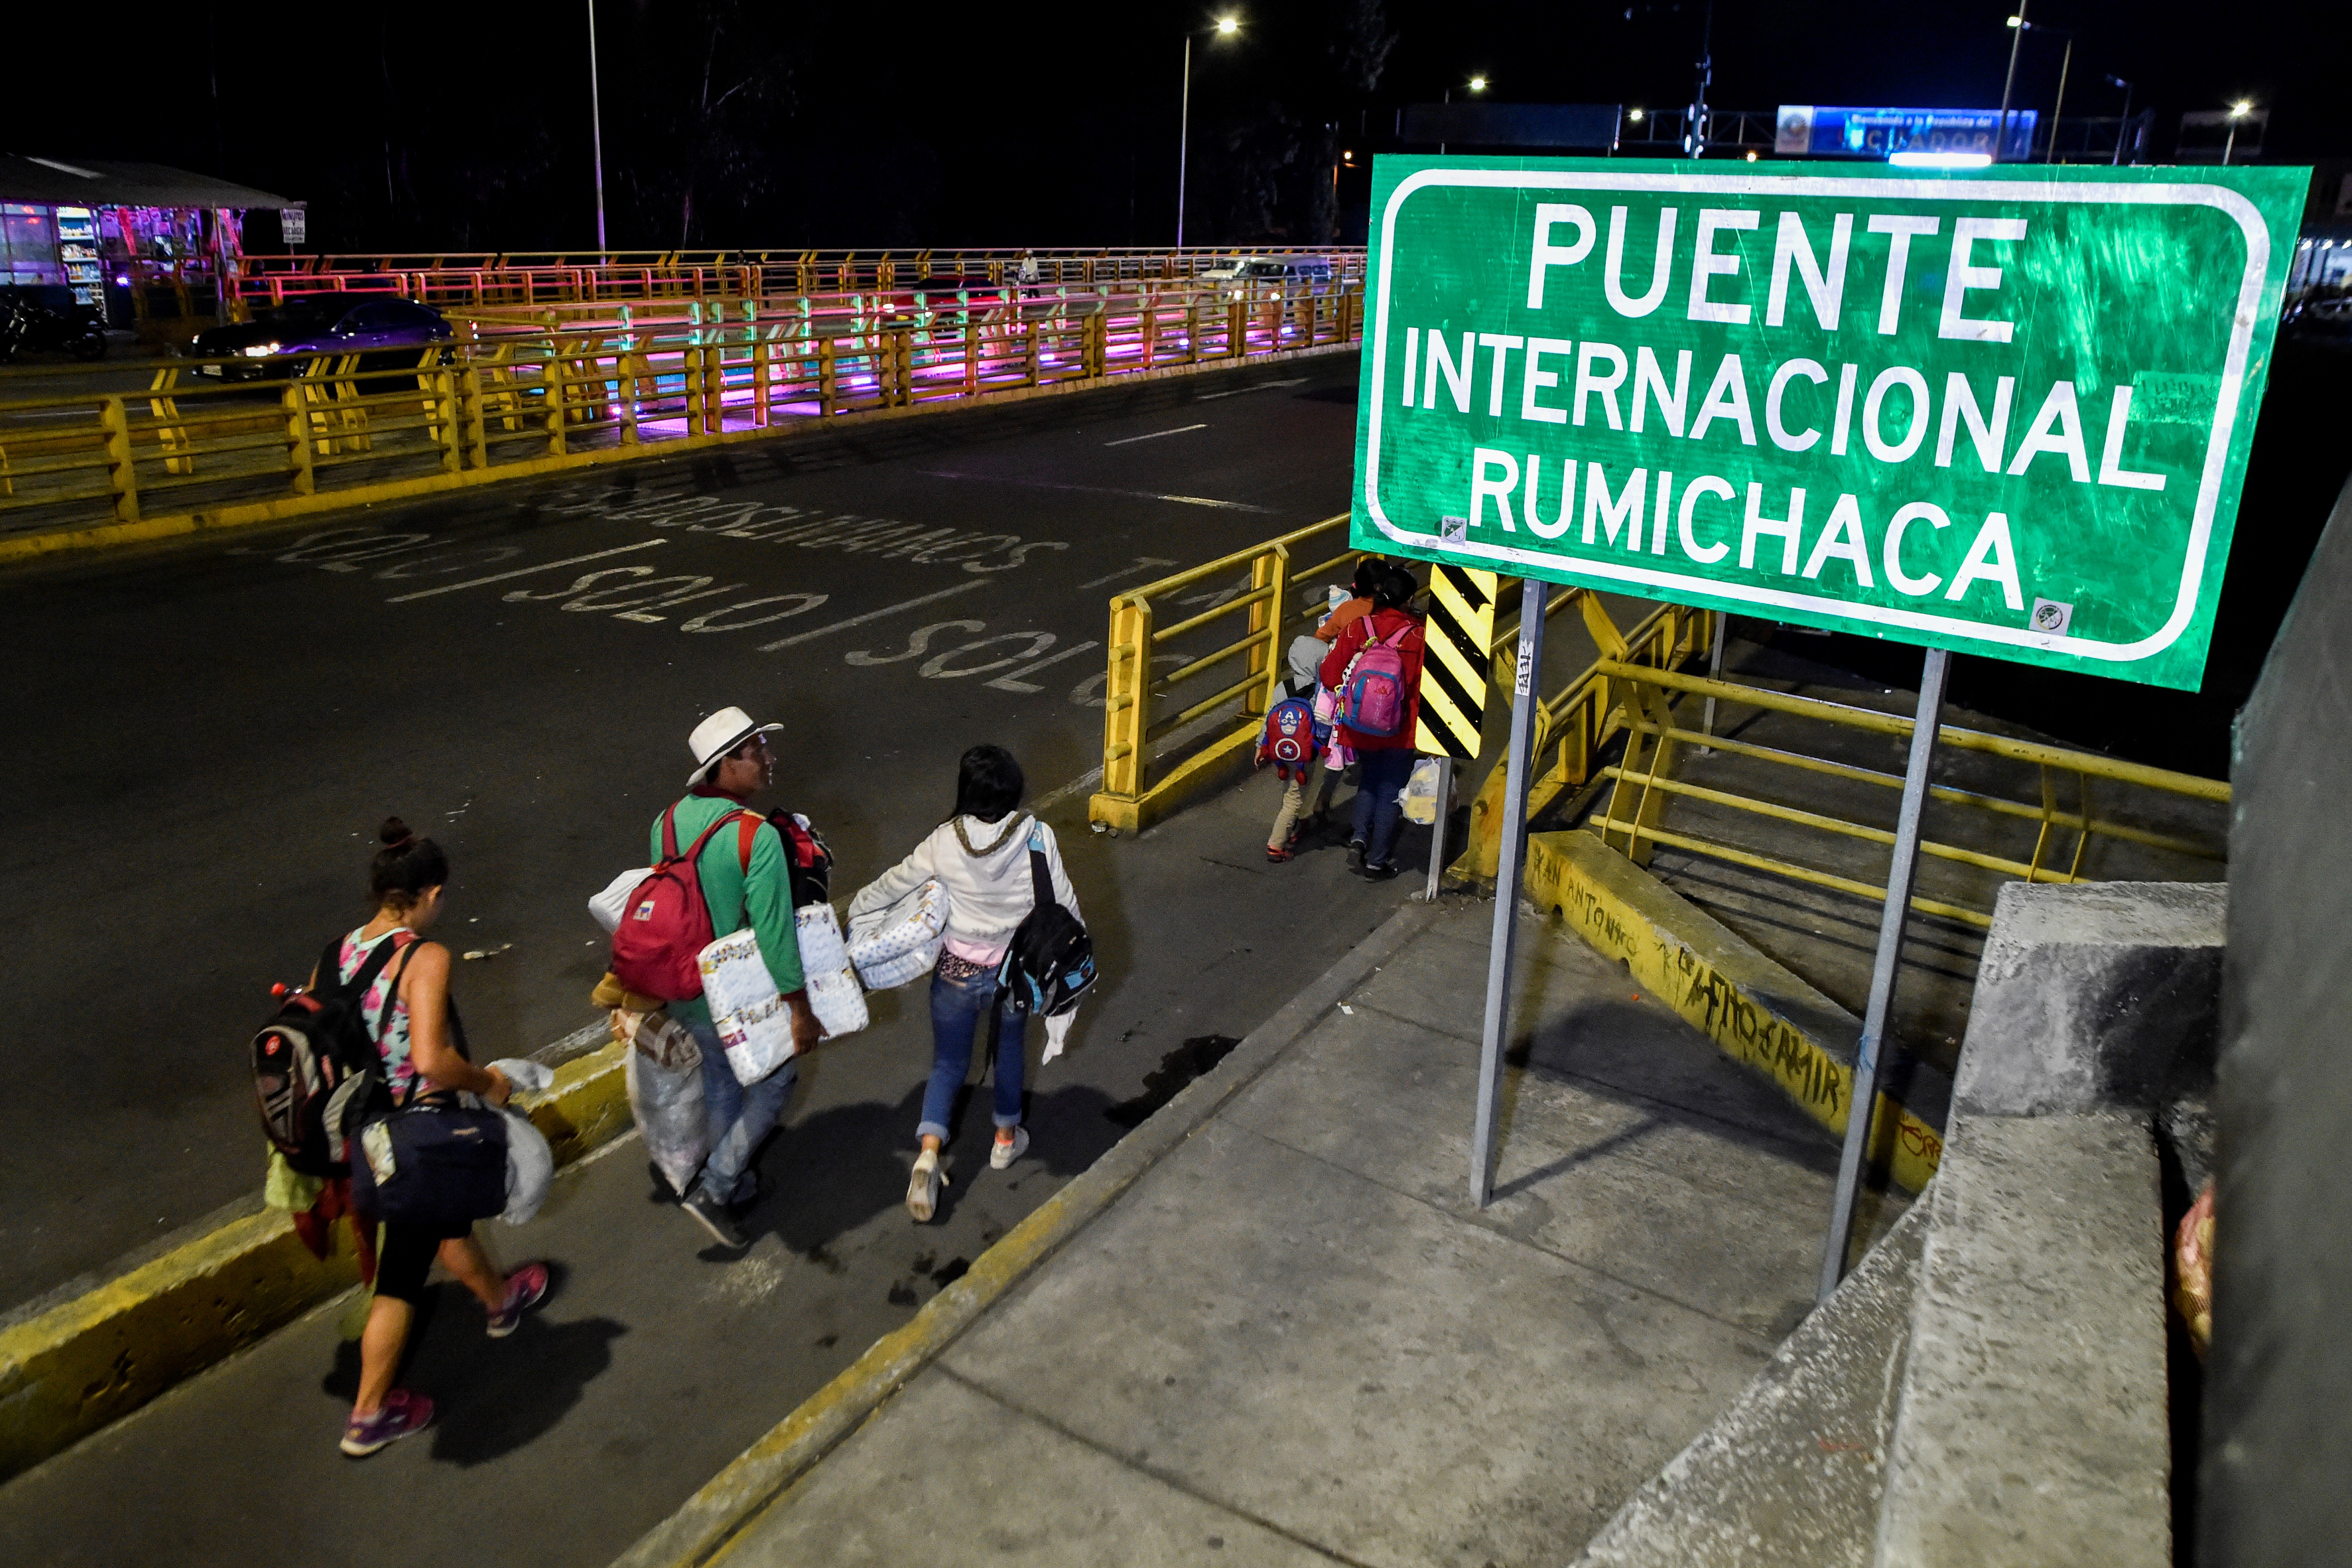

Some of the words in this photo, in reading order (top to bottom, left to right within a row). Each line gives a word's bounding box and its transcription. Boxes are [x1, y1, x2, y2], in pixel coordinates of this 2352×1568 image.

[1527, 203, 2027, 343] PUENTE
[1403, 328, 2166, 491] INTERNACIONAL
[501, 565, 829, 634] SOLO
[1469, 447, 2023, 610] RUMICHACA
